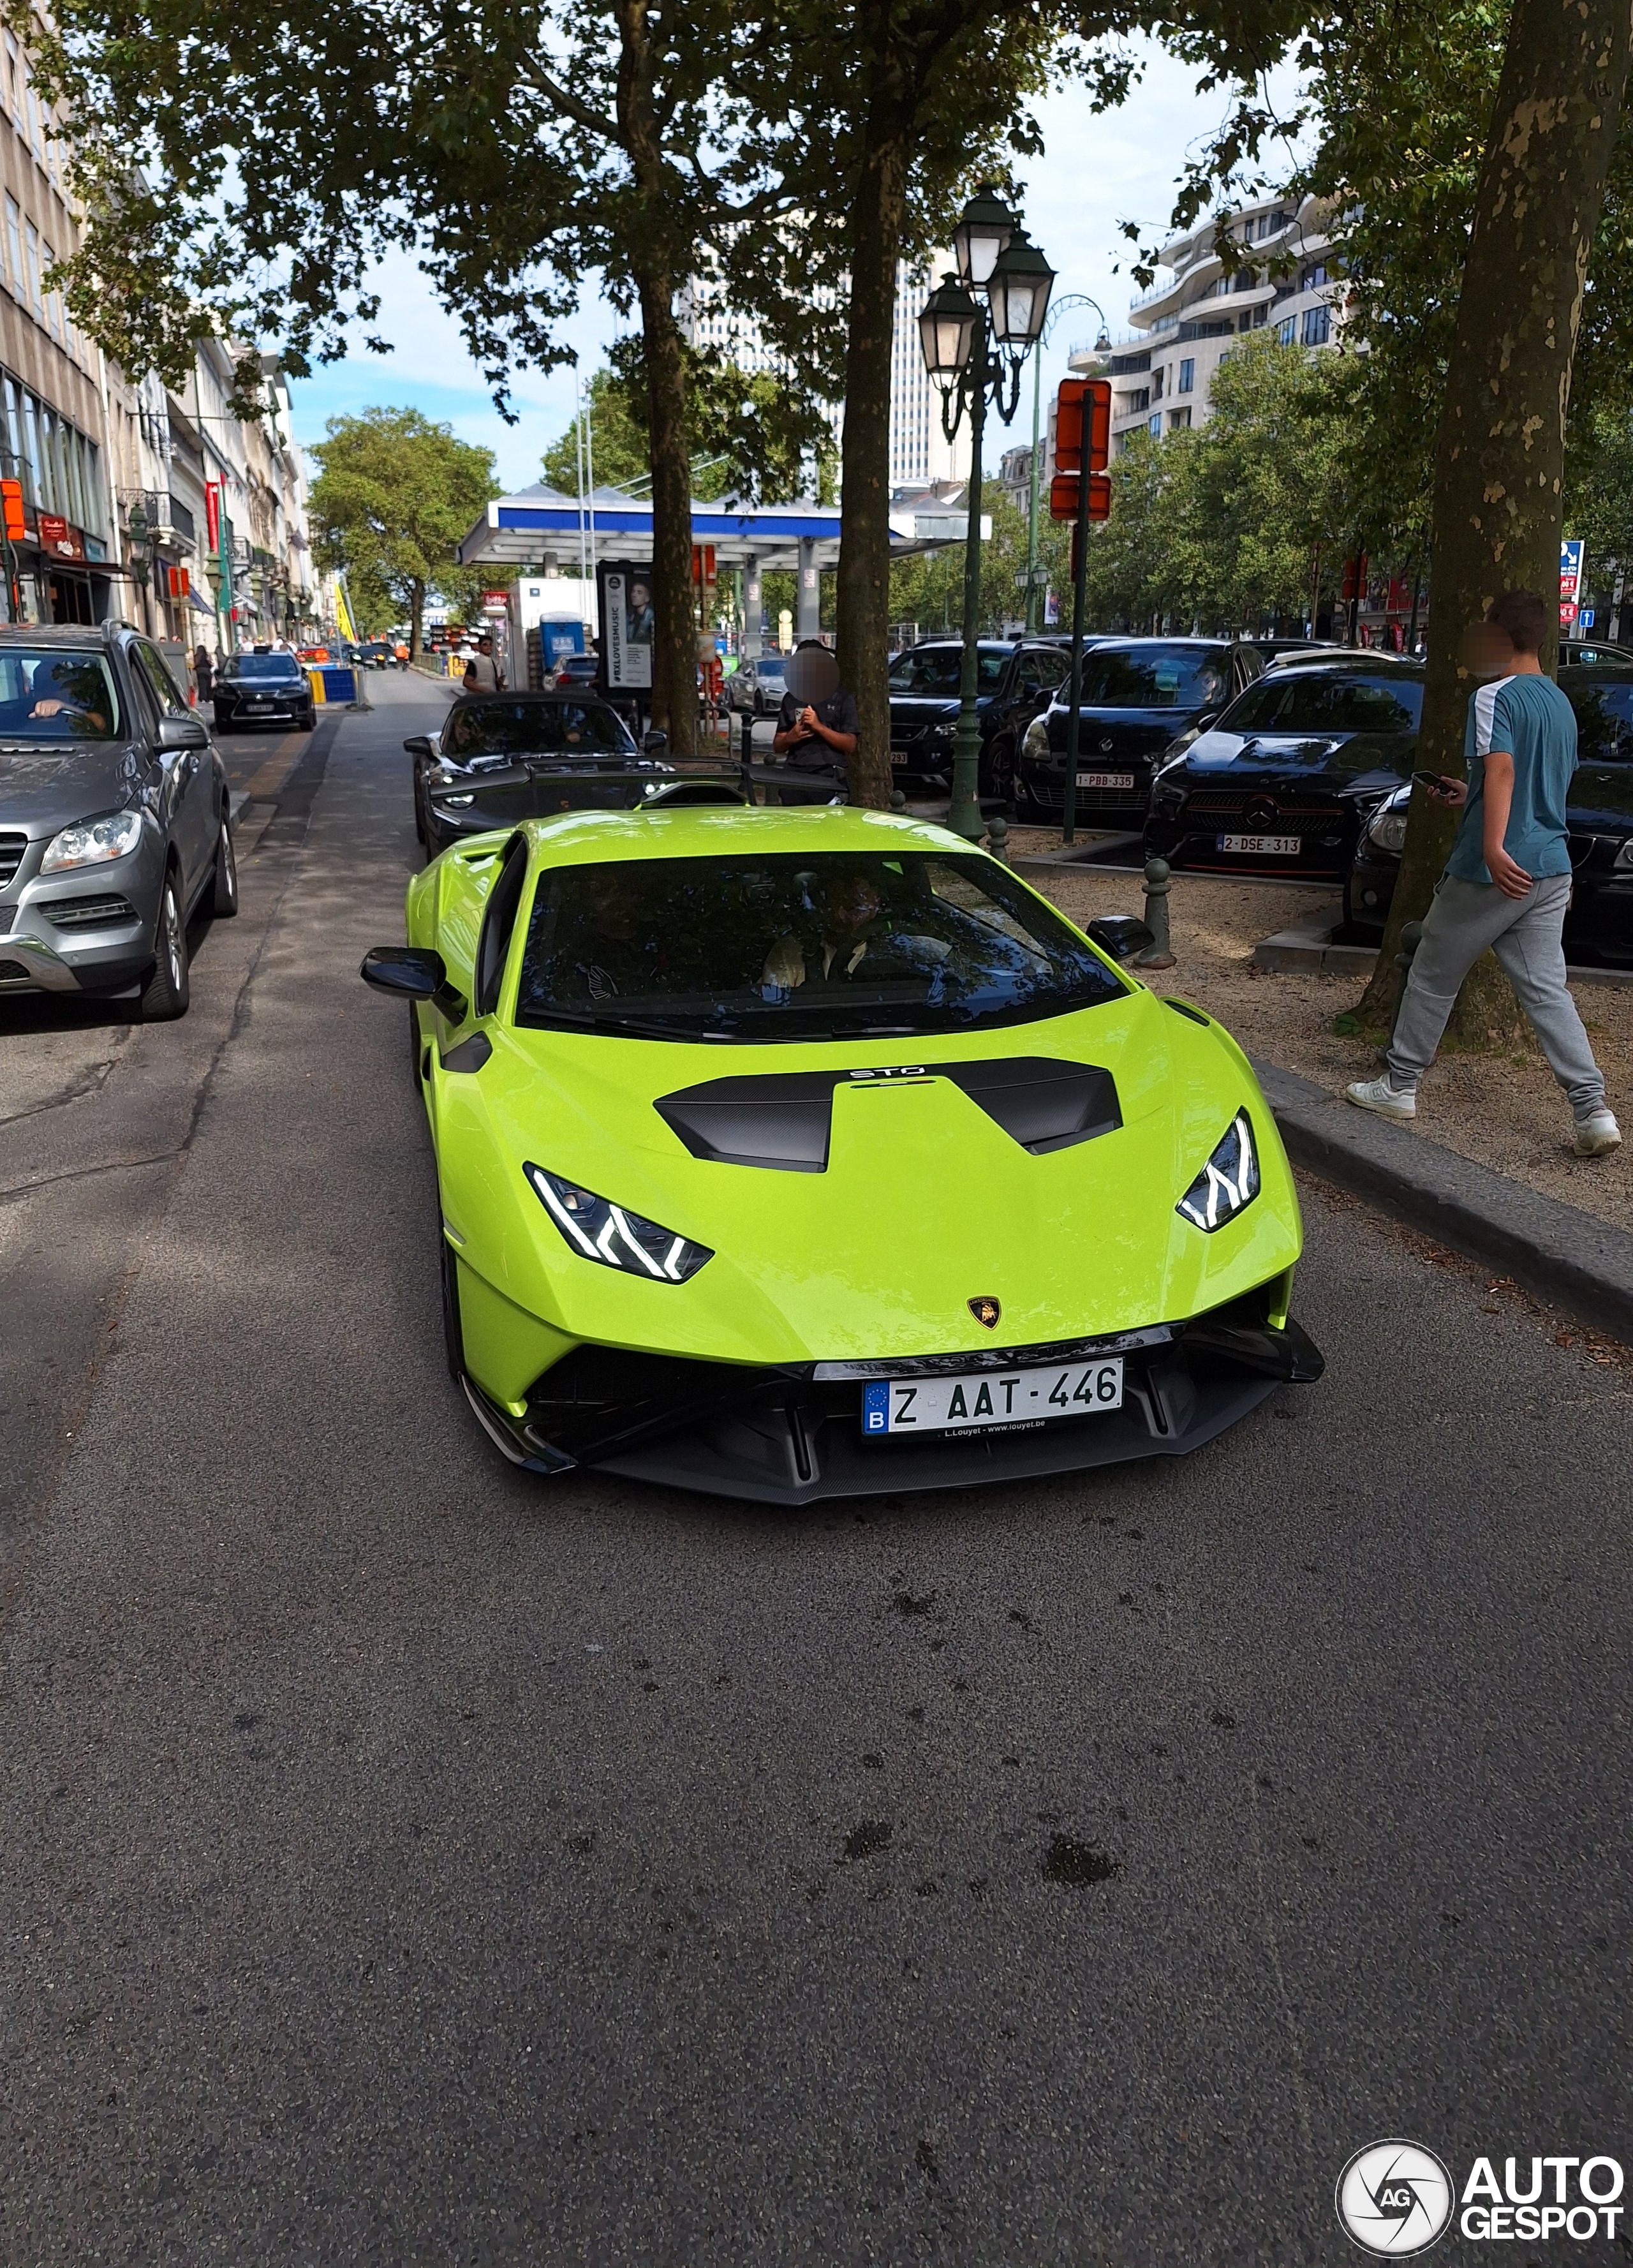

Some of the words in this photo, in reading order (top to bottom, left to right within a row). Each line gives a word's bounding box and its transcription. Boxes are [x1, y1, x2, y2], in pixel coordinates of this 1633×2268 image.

[891, 753, 906, 762] 293
[1078, 776, 1132, 786] 1-PBB-335
[1225, 837, 1299, 852] 2-DSE-313
[850, 1067, 925, 1078] STO
[869, 1411, 884, 1429] B
[894, 1388, 917, 1424] Z
[945, 1427, 981, 1437] L.Louyet
[987, 1419, 1046, 1433] www.louyet.be
